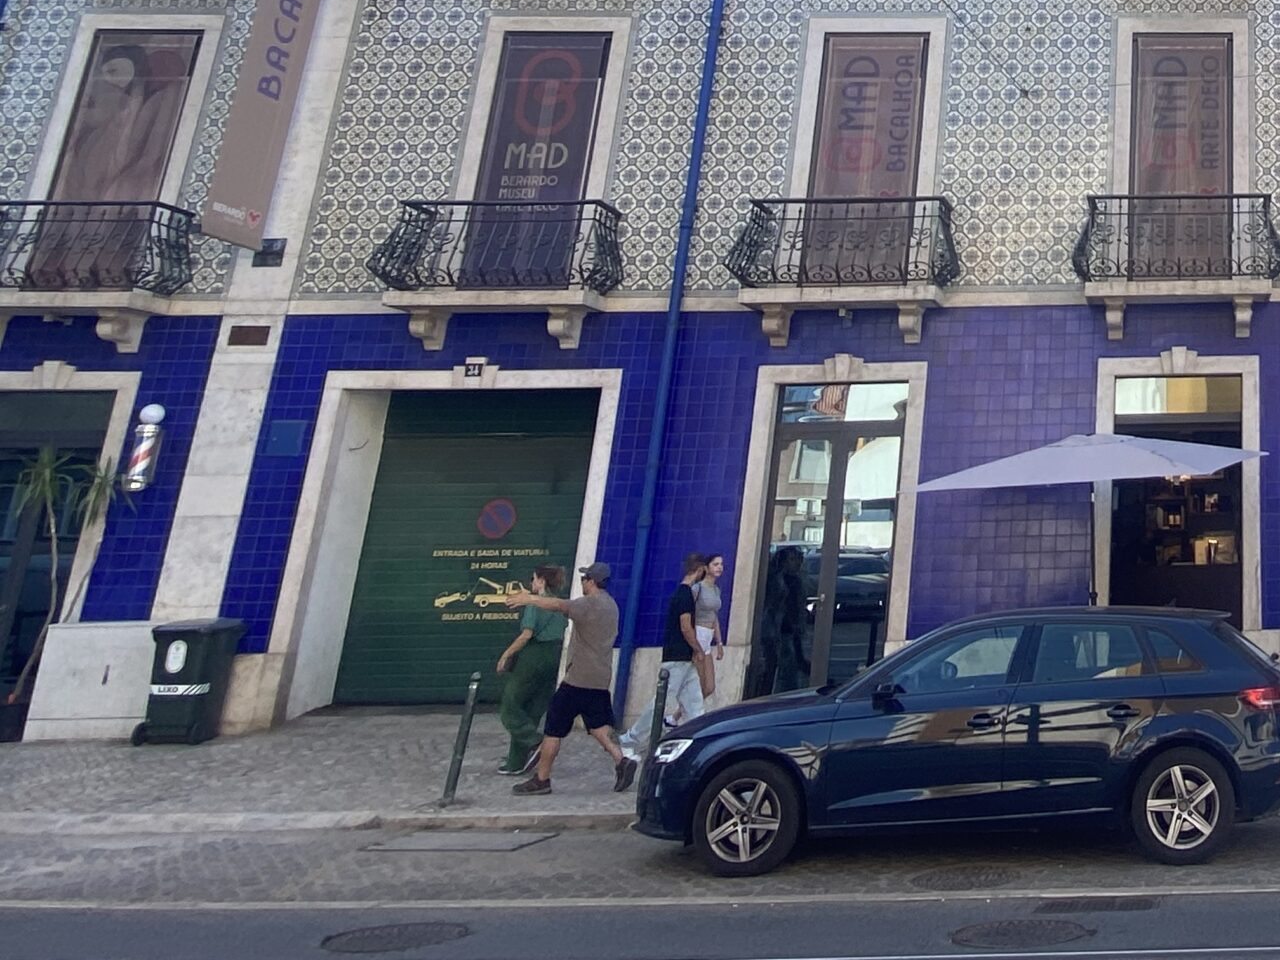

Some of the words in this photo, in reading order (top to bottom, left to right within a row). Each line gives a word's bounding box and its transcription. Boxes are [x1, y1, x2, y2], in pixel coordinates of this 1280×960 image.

[1153, 55, 1188, 129] MAD
[1201, 55, 1220, 110] DECO
[838, 55, 880, 131] MAD
[1201, 119, 1220, 170] ARTE
[504, 142, 569, 170] MAD
[500, 175, 559, 187] BERARDO
[498, 187, 536, 199] MUSEU
[432, 549, 469, 557] ENTRADA
[469, 549, 475, 557] E
[480, 561, 509, 569] HORAS
[475, 612, 481, 620] A
